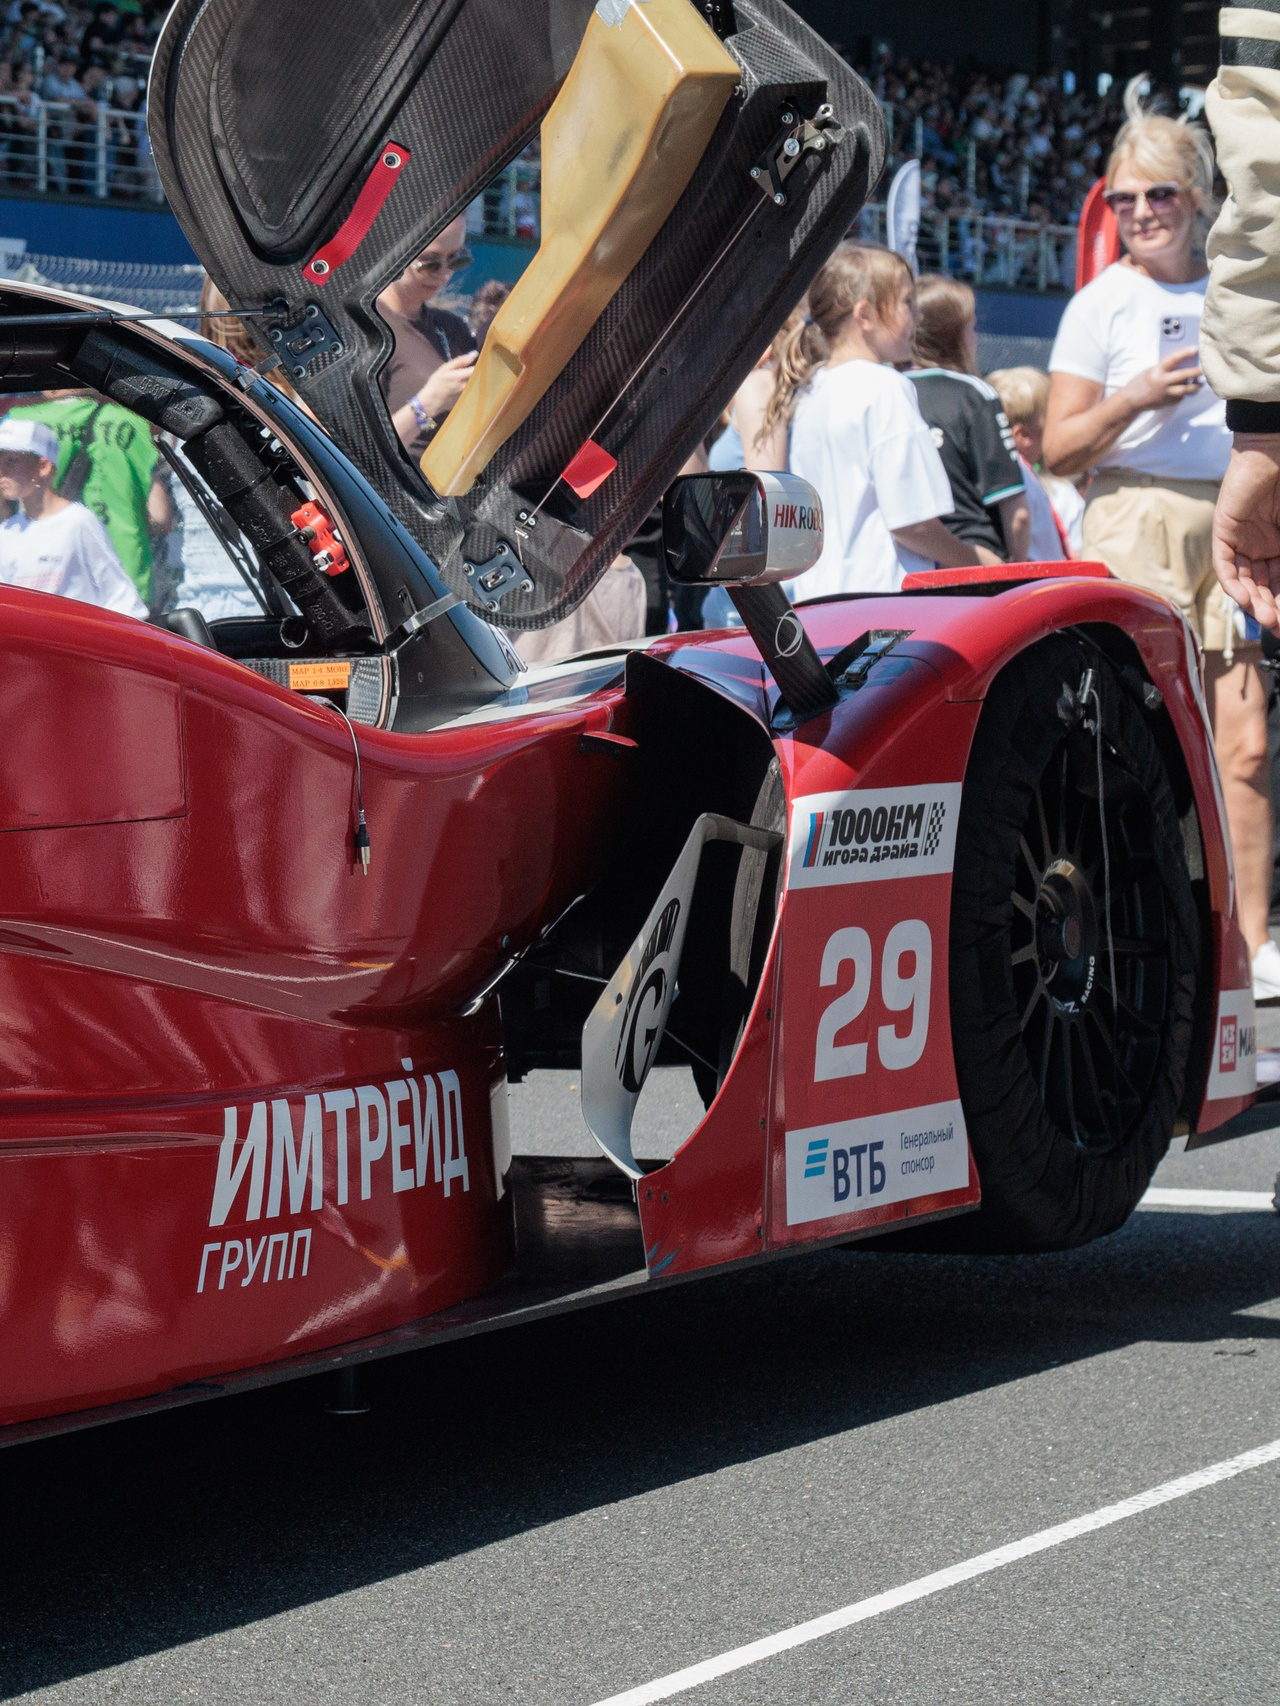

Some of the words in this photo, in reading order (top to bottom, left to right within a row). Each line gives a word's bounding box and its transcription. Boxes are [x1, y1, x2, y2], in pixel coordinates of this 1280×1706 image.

[292, 680, 310, 688] MAP
[327, 677, 347, 686] LESS
[326, 664, 349, 673] MORE
[814, 919, 932, 1083] 29
[1080, 955, 1096, 1004] RACING
[208, 1056, 470, 1228] ИМТРЕЙД
[900, 1122, 954, 1151] Генеральный
[832, 1140, 887, 1203] ВТБ
[900, 1155, 936, 1176] спонсор
[196, 1228, 313, 1294] ГРУПП
